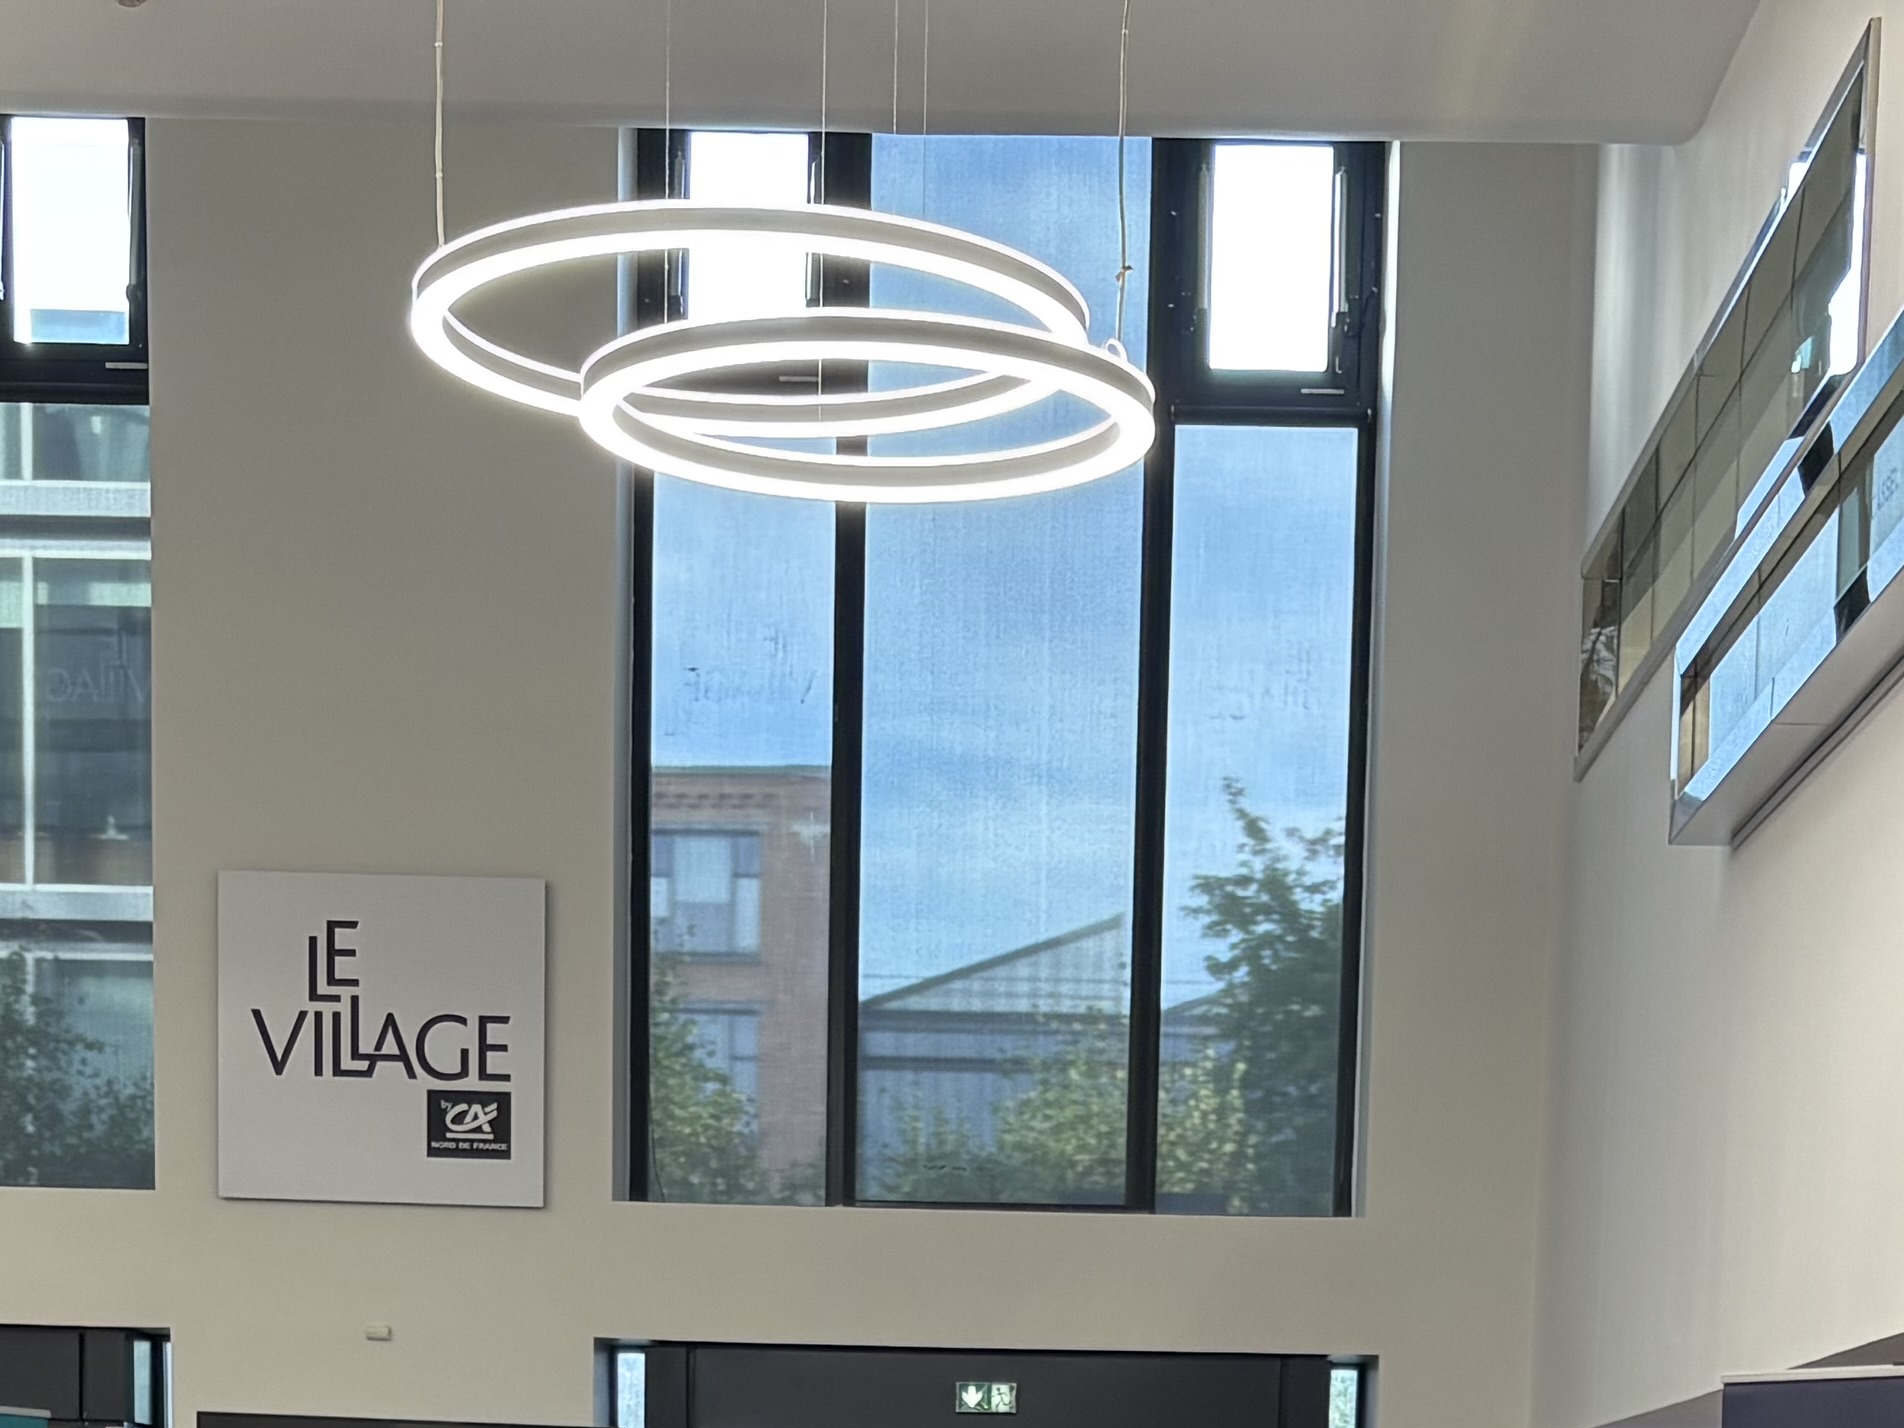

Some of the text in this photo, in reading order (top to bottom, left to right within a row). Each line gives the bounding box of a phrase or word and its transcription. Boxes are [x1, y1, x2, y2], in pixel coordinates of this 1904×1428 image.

[308, 920, 359, 1002] LE
[251, 994, 511, 1082] VILLAGE
[431, 1141, 456, 1149] NORD
[473, 1142, 508, 1151] FRANCE
